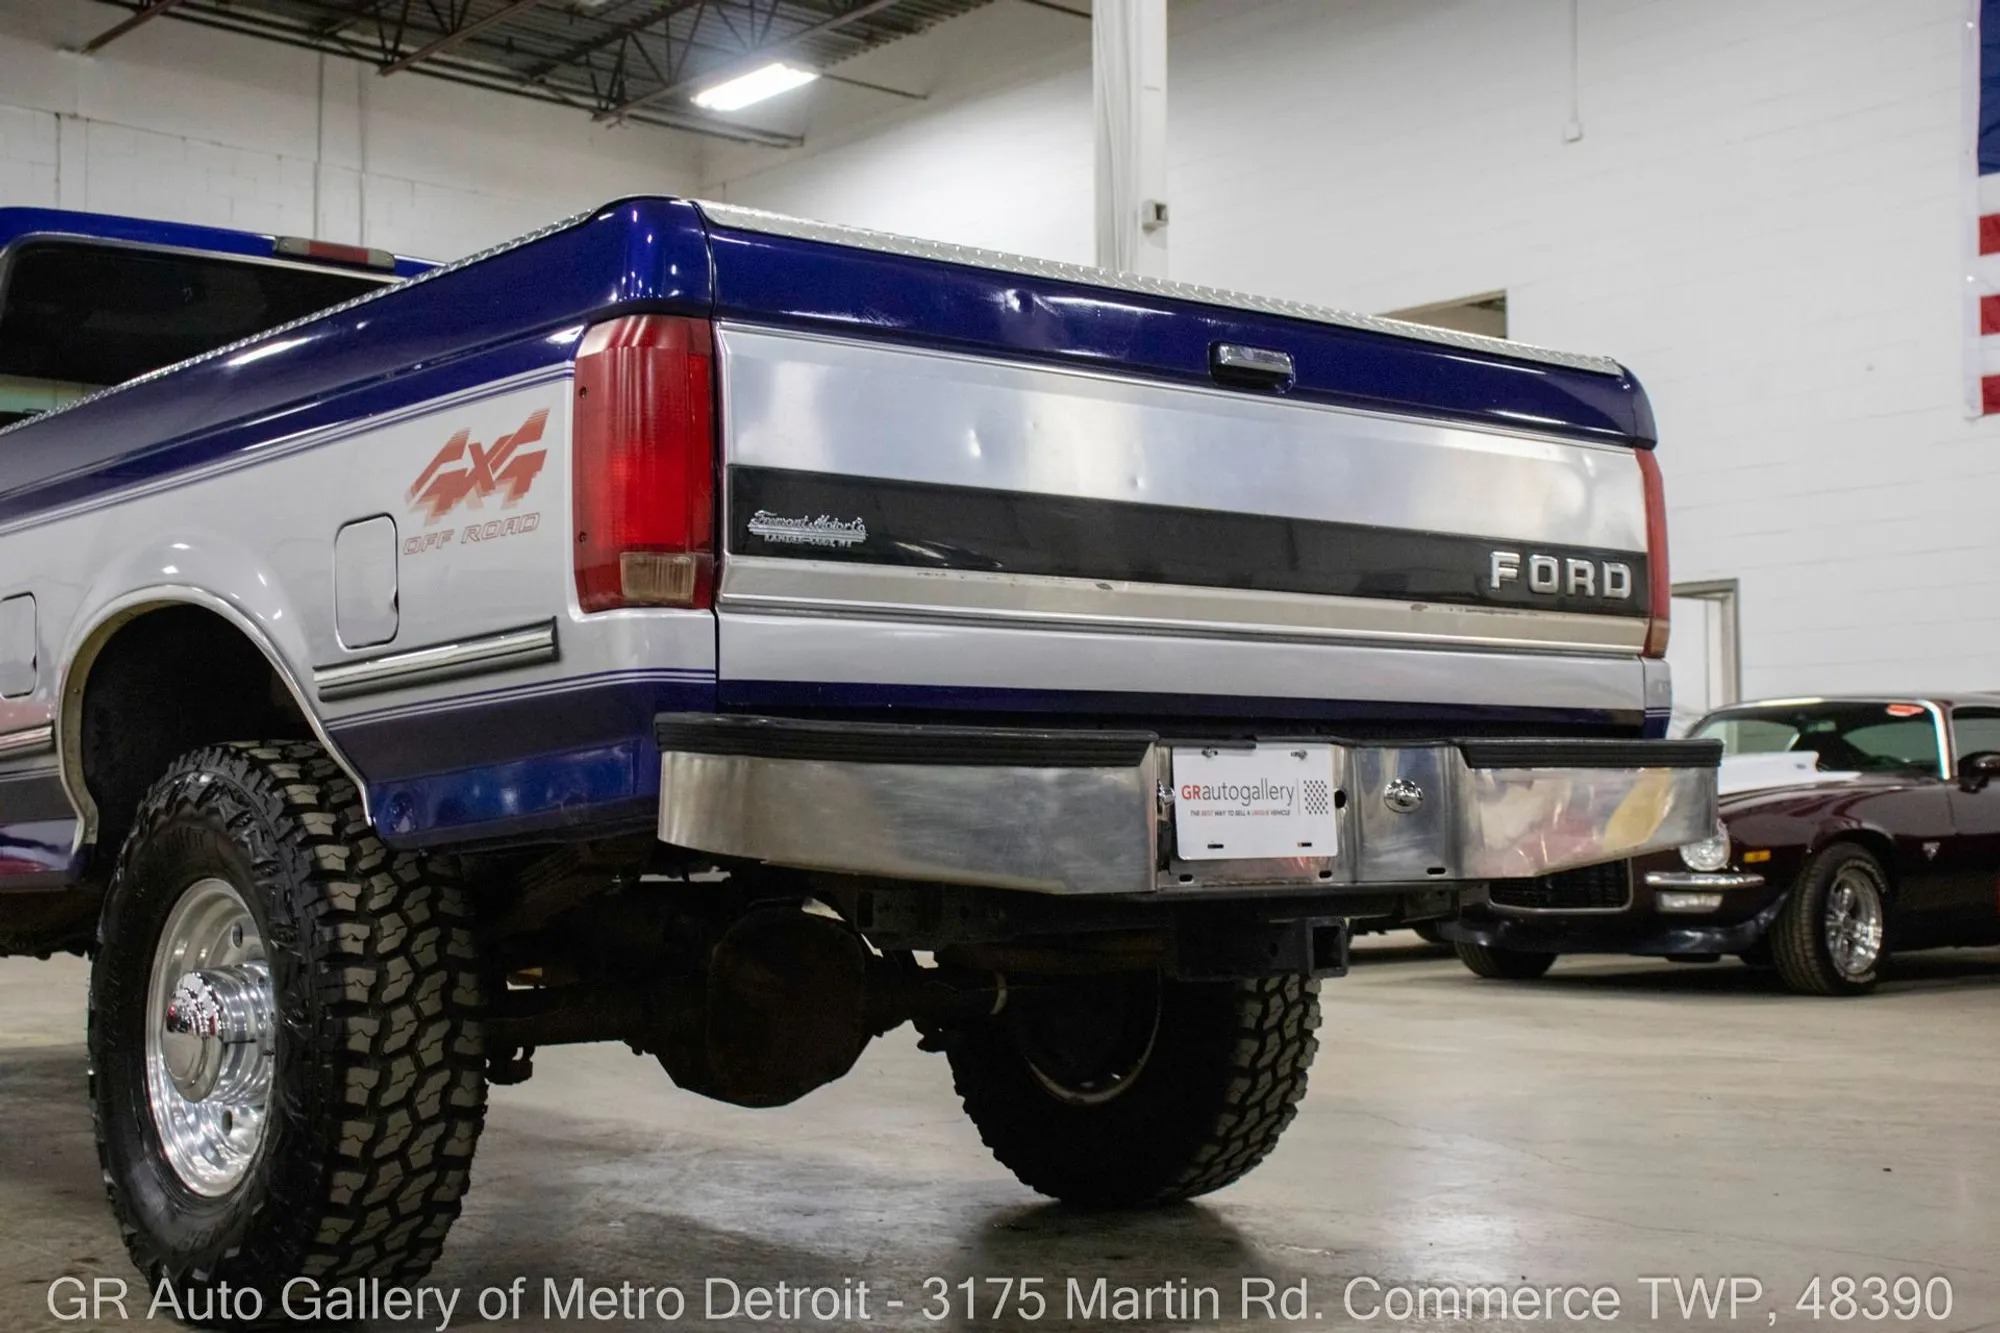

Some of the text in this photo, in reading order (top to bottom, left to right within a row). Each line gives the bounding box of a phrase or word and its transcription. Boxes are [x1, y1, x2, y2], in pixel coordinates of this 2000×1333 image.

[402, 512, 541, 556] OFF ROAD
[1490, 551, 1632, 600] FORD
[1181, 777, 1294, 807] GRautogallery
